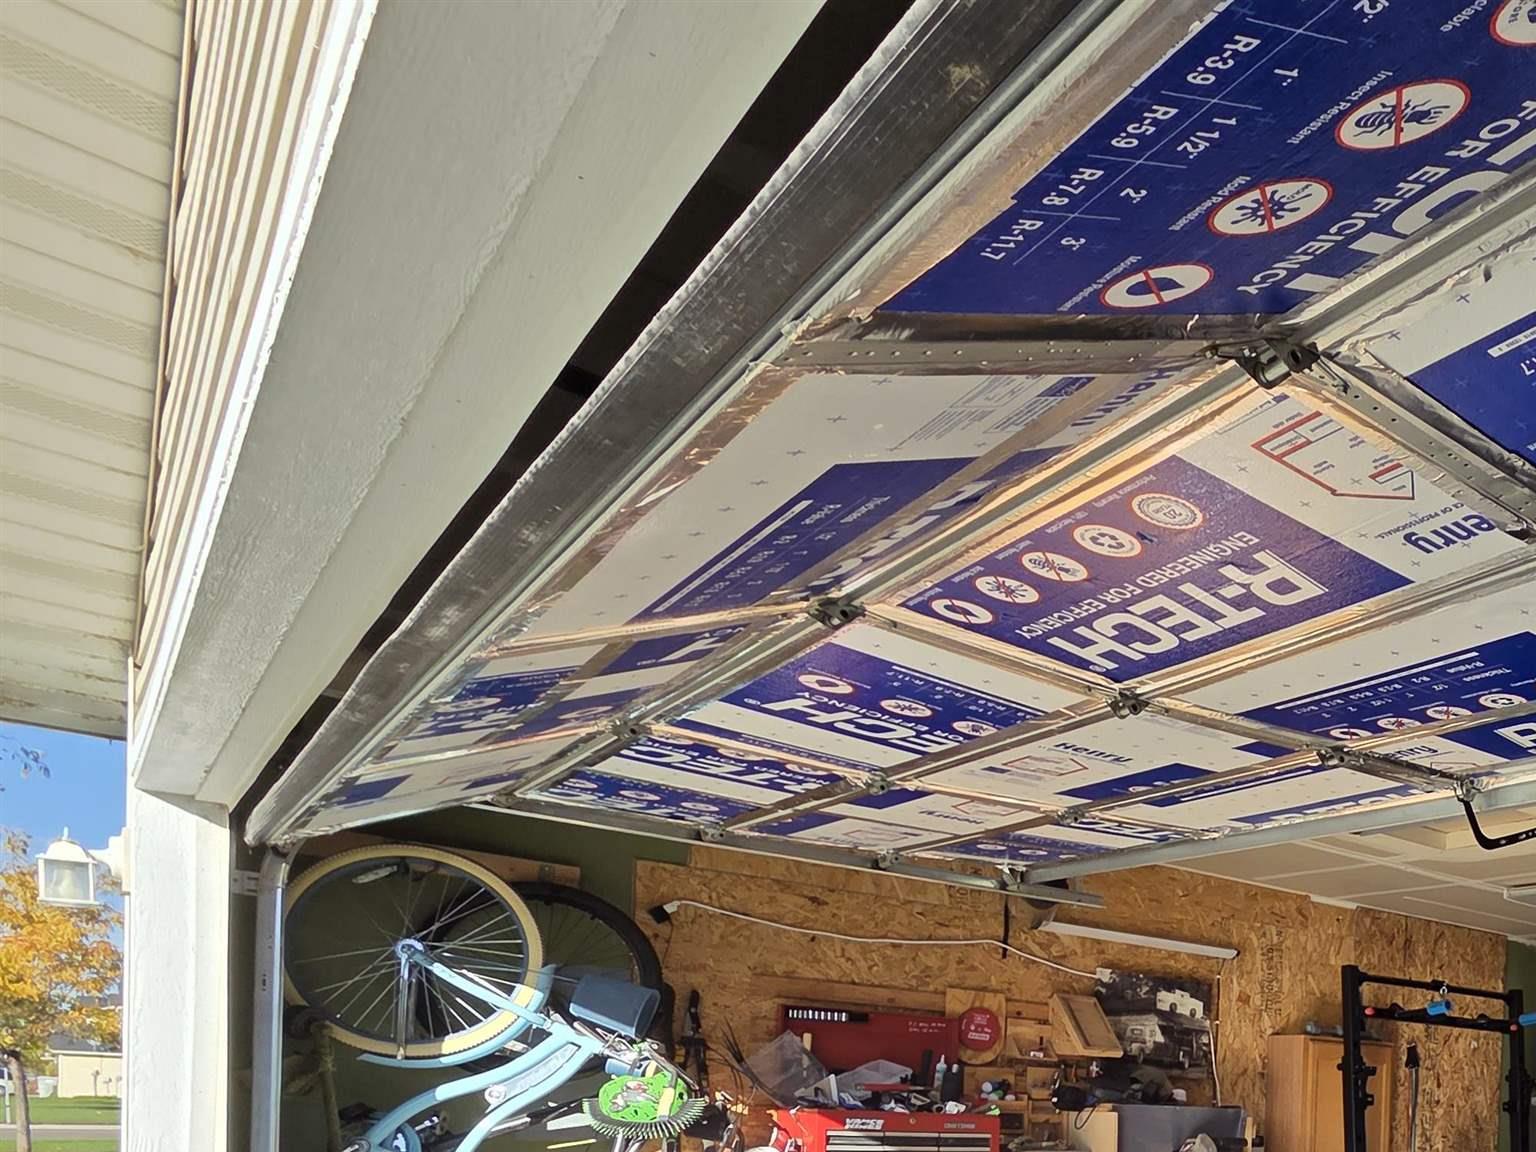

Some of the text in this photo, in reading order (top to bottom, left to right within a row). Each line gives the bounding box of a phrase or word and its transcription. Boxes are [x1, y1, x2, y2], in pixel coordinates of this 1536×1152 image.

[1186, 34, 1262, 85] R-3.9
[1111, 104, 1179, 148] R-5.9
[1287, 70, 1393, 145] Insect Resistant
[1042, 167, 1104, 206] R-7.8
[980, 218, 1043, 261] R-11.7
[1236, 165, 1452, 296] EFFICIENCY
[1403, 513, 1496, 554] enry
[1014, 531, 1260, 640] ENGINEERED FOR EFFICIENCY
[1048, 549, 1330, 671] R-TECH
[796, 692, 933, 732] EFFICIENCY
